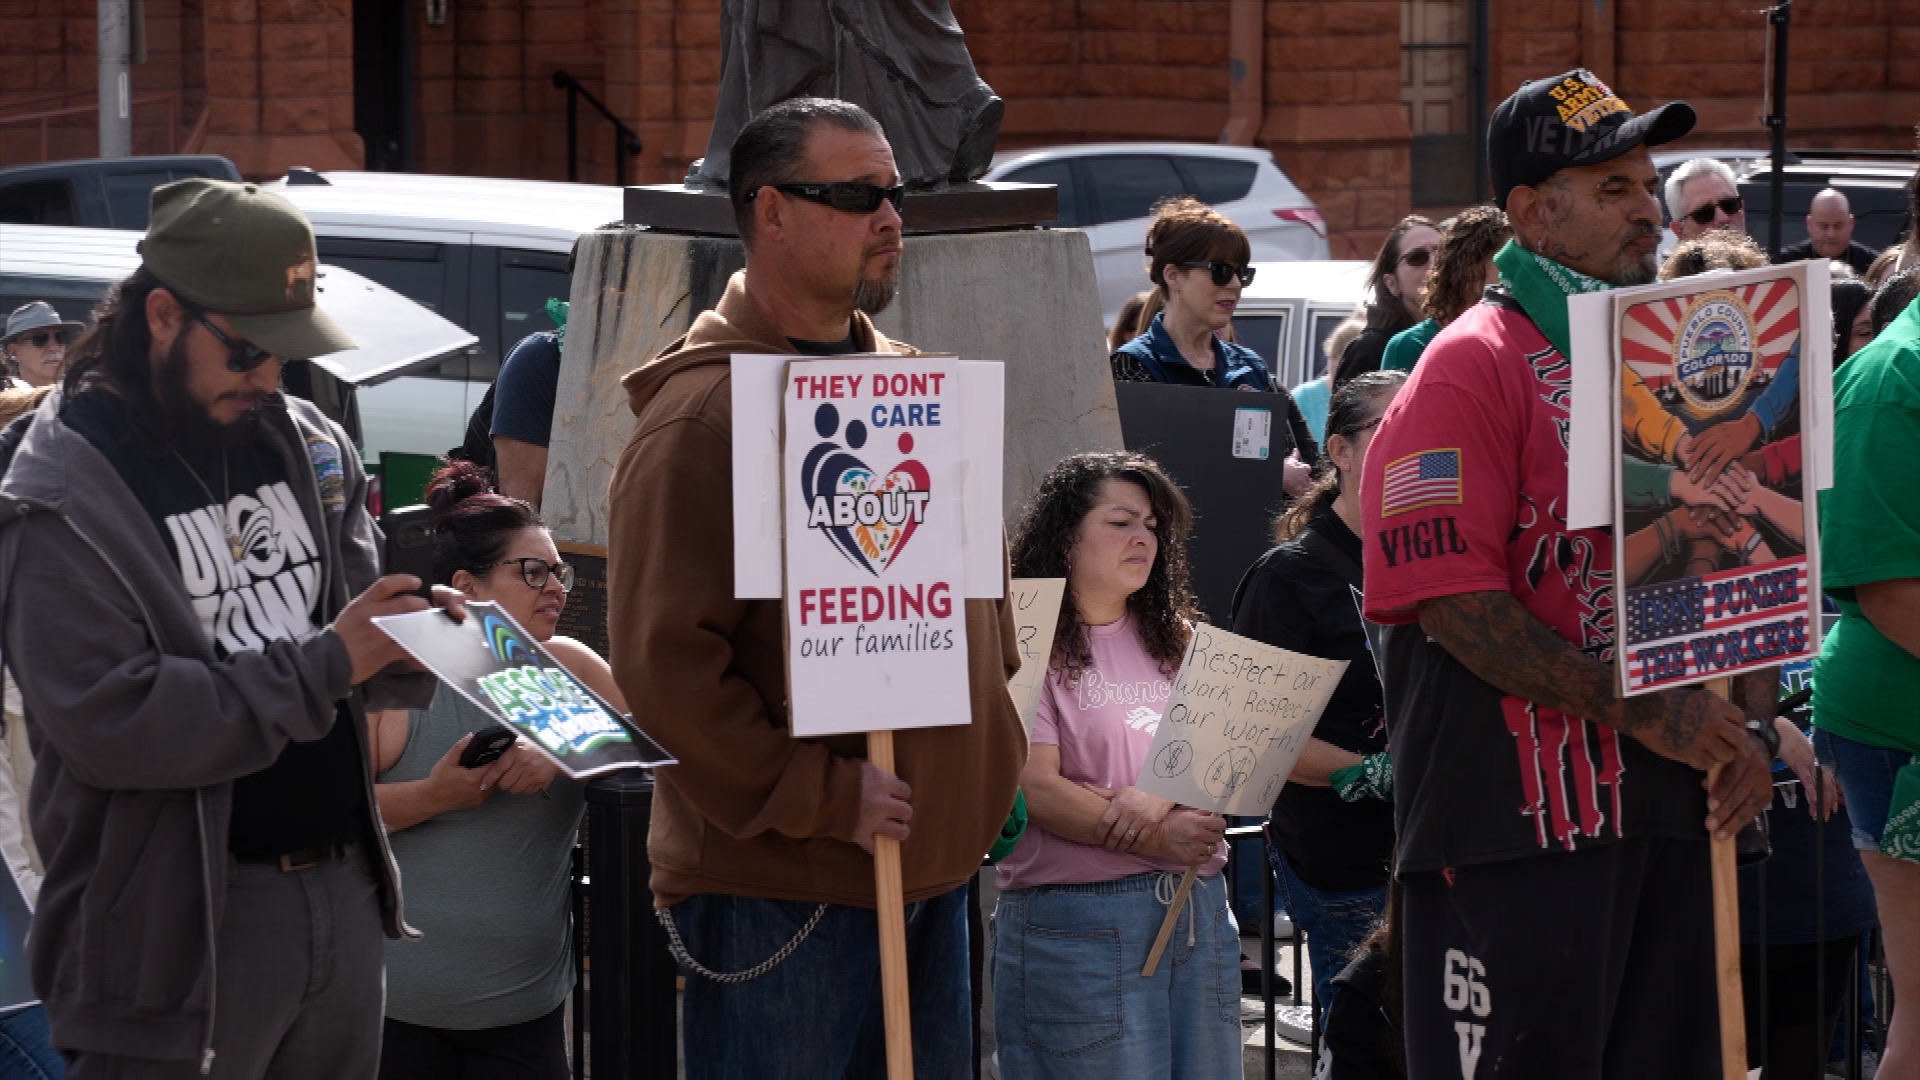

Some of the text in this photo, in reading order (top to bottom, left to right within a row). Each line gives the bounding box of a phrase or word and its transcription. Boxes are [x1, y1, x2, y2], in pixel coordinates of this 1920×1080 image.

[1556, 86, 1604, 122] ARMY
[1682, 306, 1748, 358] PUEBLO COUNTY
[1682, 353, 1748, 373] COLORADO
[794, 372, 945, 400] THEY DONT
[871, 403, 941, 428] CARE
[808, 490, 930, 528] ABOUT
[1379, 516, 1468, 568] VIGIL
[799, 582, 952, 626] FEEDING
[1640, 568, 1798, 630] DONT PUNISH
[801, 622, 953, 658] our families
[1188, 631, 1286, 685] Respect
[1637, 617, 1805, 684] THE WORKERS
[1169, 703, 1215, 729] Our
[1243, 690, 1311, 719] Respect
[1443, 947, 1491, 1018] 66
